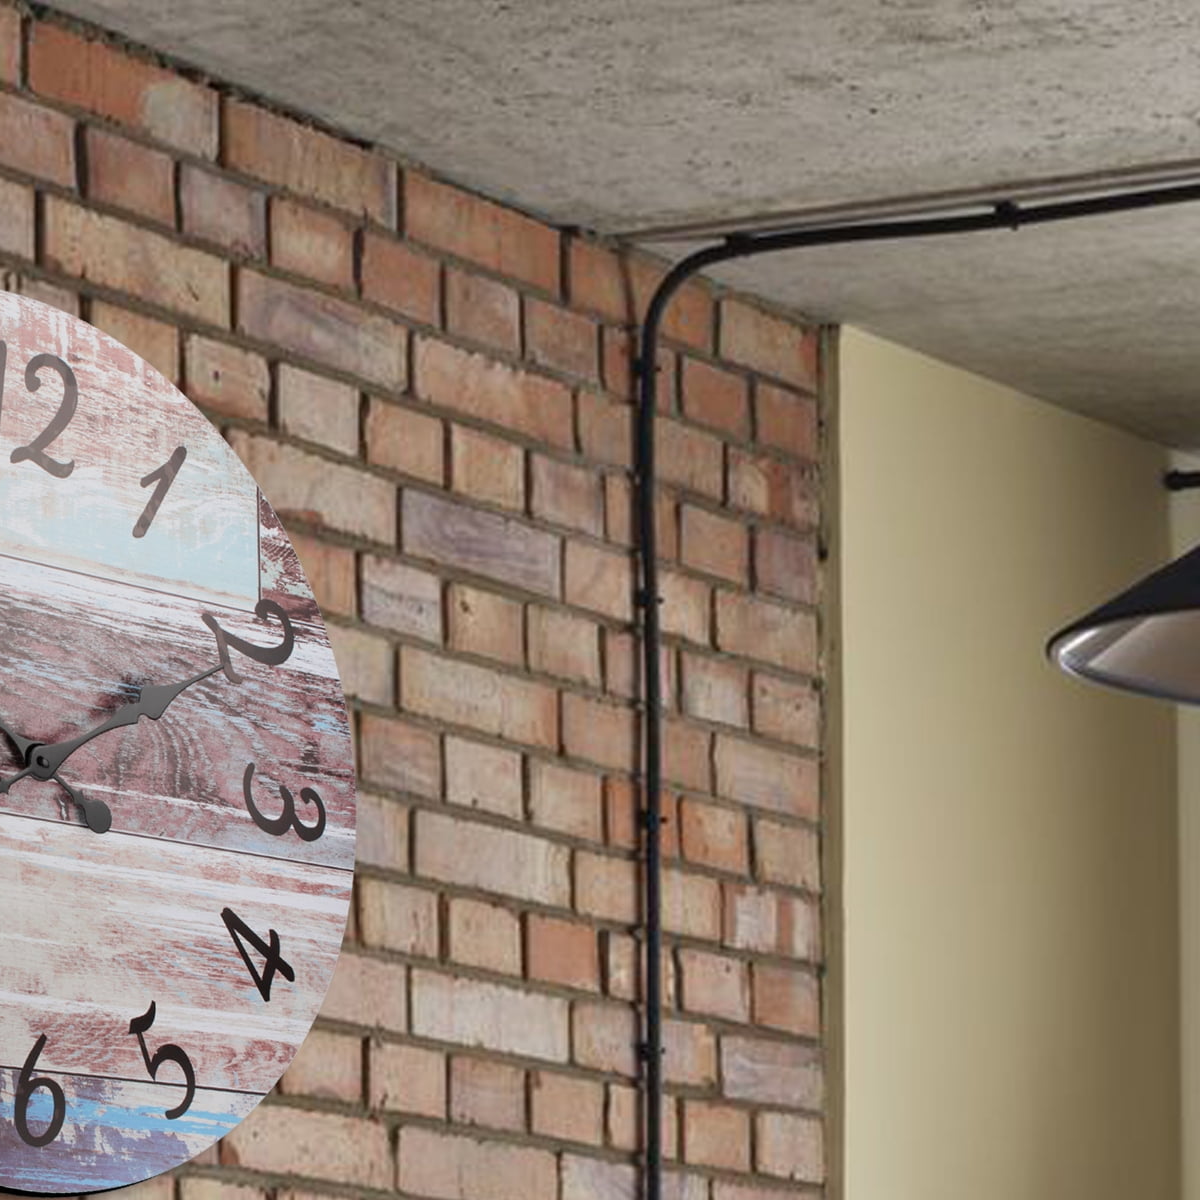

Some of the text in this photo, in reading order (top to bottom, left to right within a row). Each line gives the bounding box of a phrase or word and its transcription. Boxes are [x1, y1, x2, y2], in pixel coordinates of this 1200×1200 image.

[131, 446, 186, 539] 1
[201, 599, 294, 685] 2
[243, 762, 327, 842] 3
[221, 907, 295, 1003] 4
[14, 1034, 66, 1148] 6
[129, 1001, 196, 1120] 5
